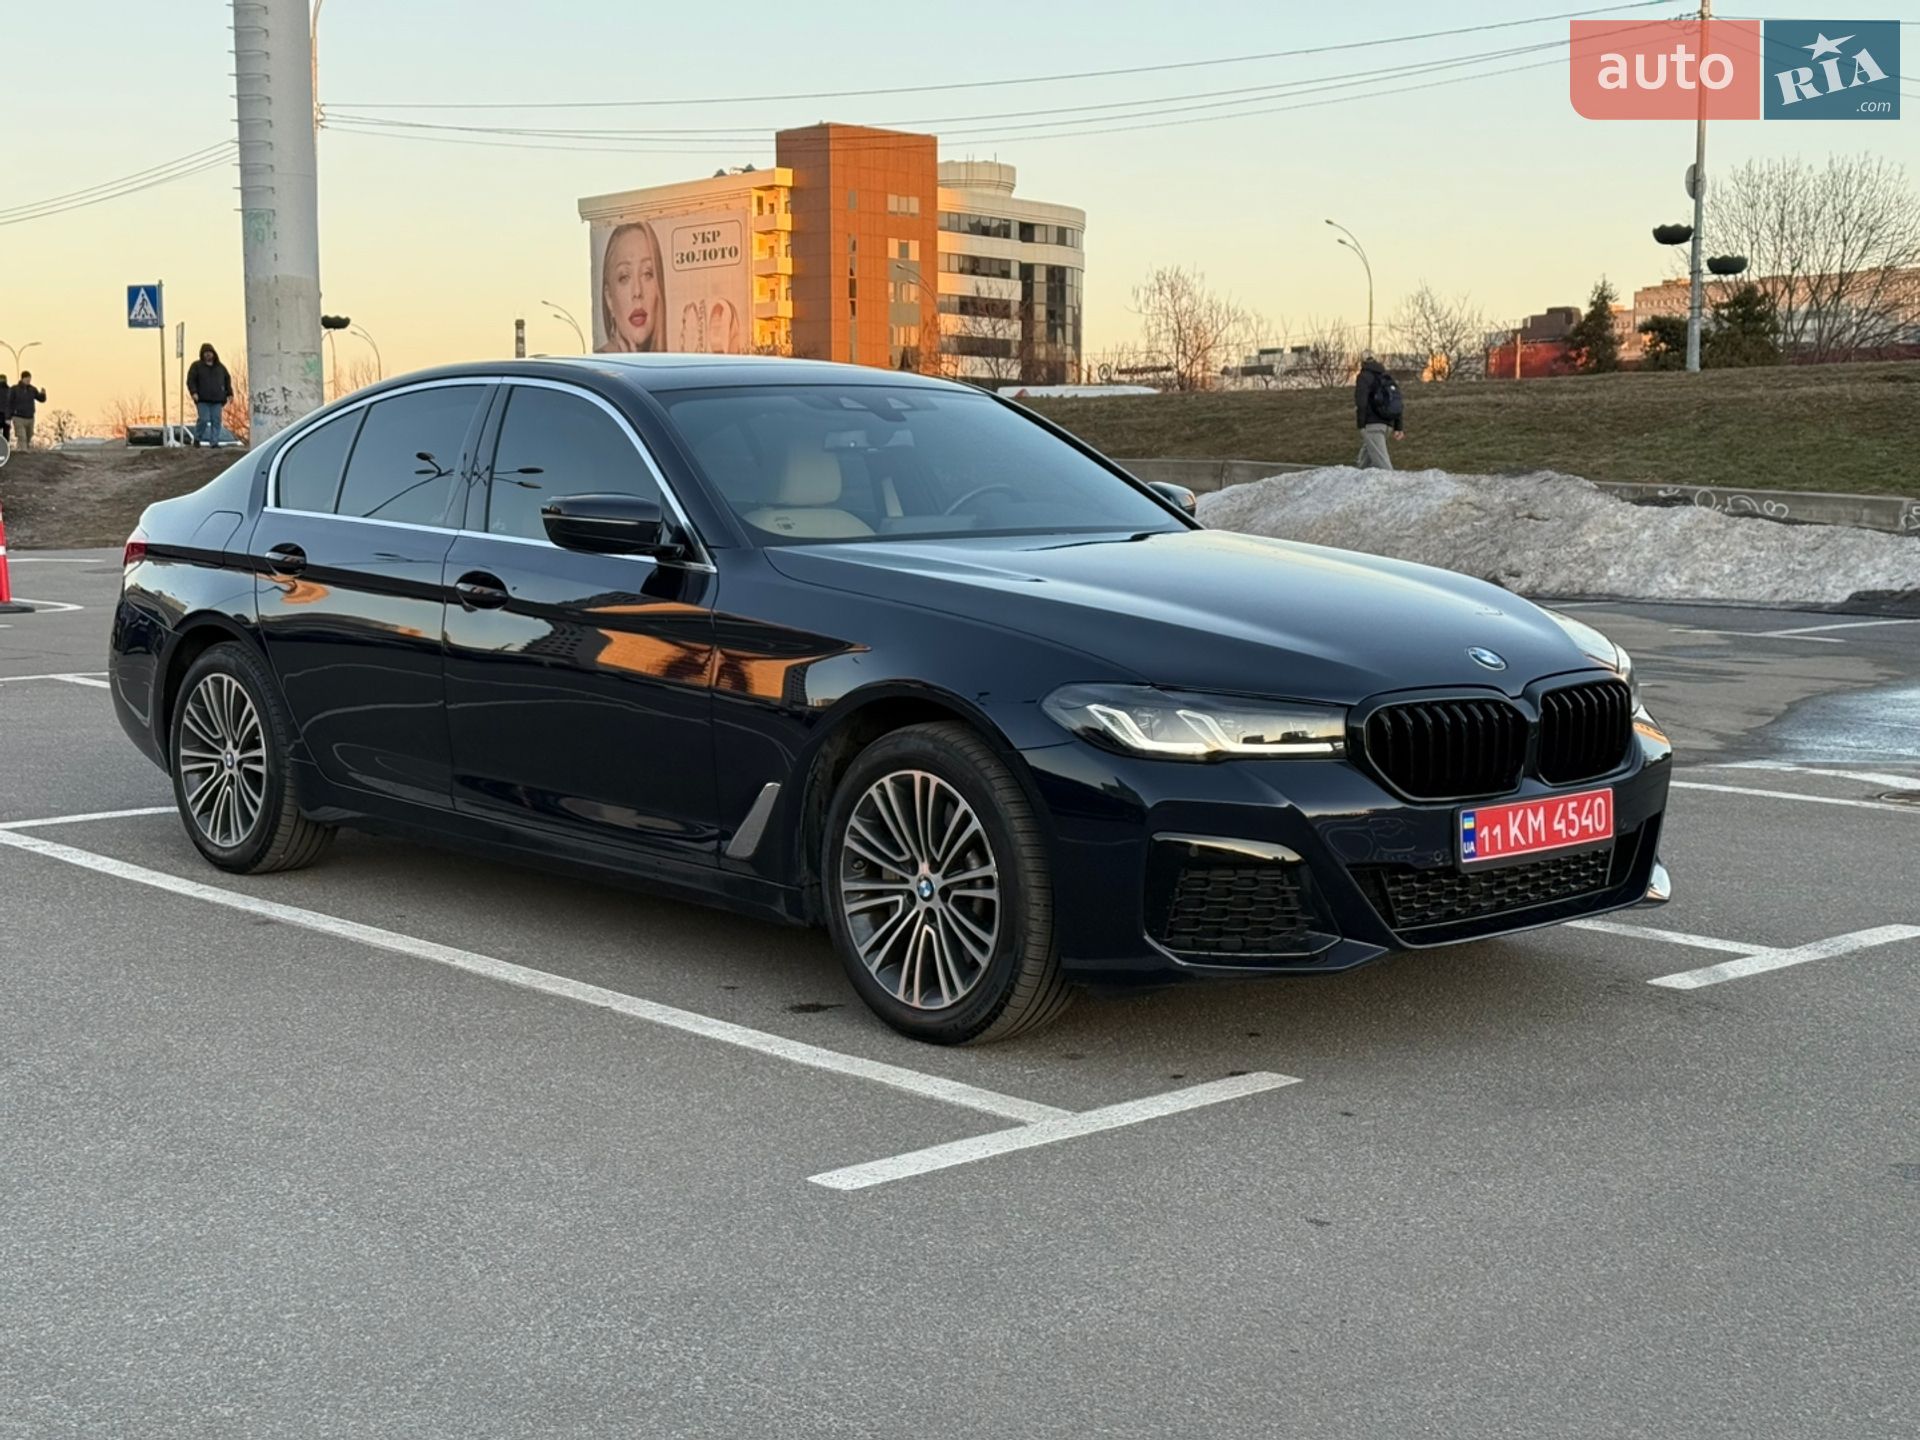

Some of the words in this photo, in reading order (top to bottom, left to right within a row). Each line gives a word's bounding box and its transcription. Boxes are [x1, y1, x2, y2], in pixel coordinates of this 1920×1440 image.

[692, 230, 721, 245] УКР
[675, 245, 739, 264] ЗОЛОТО
[1479, 823, 1502, 853] 11
[1508, 806, 1546, 847] KM
[1553, 797, 1606, 839] 4540
[1463, 841, 1476, 853] UA
